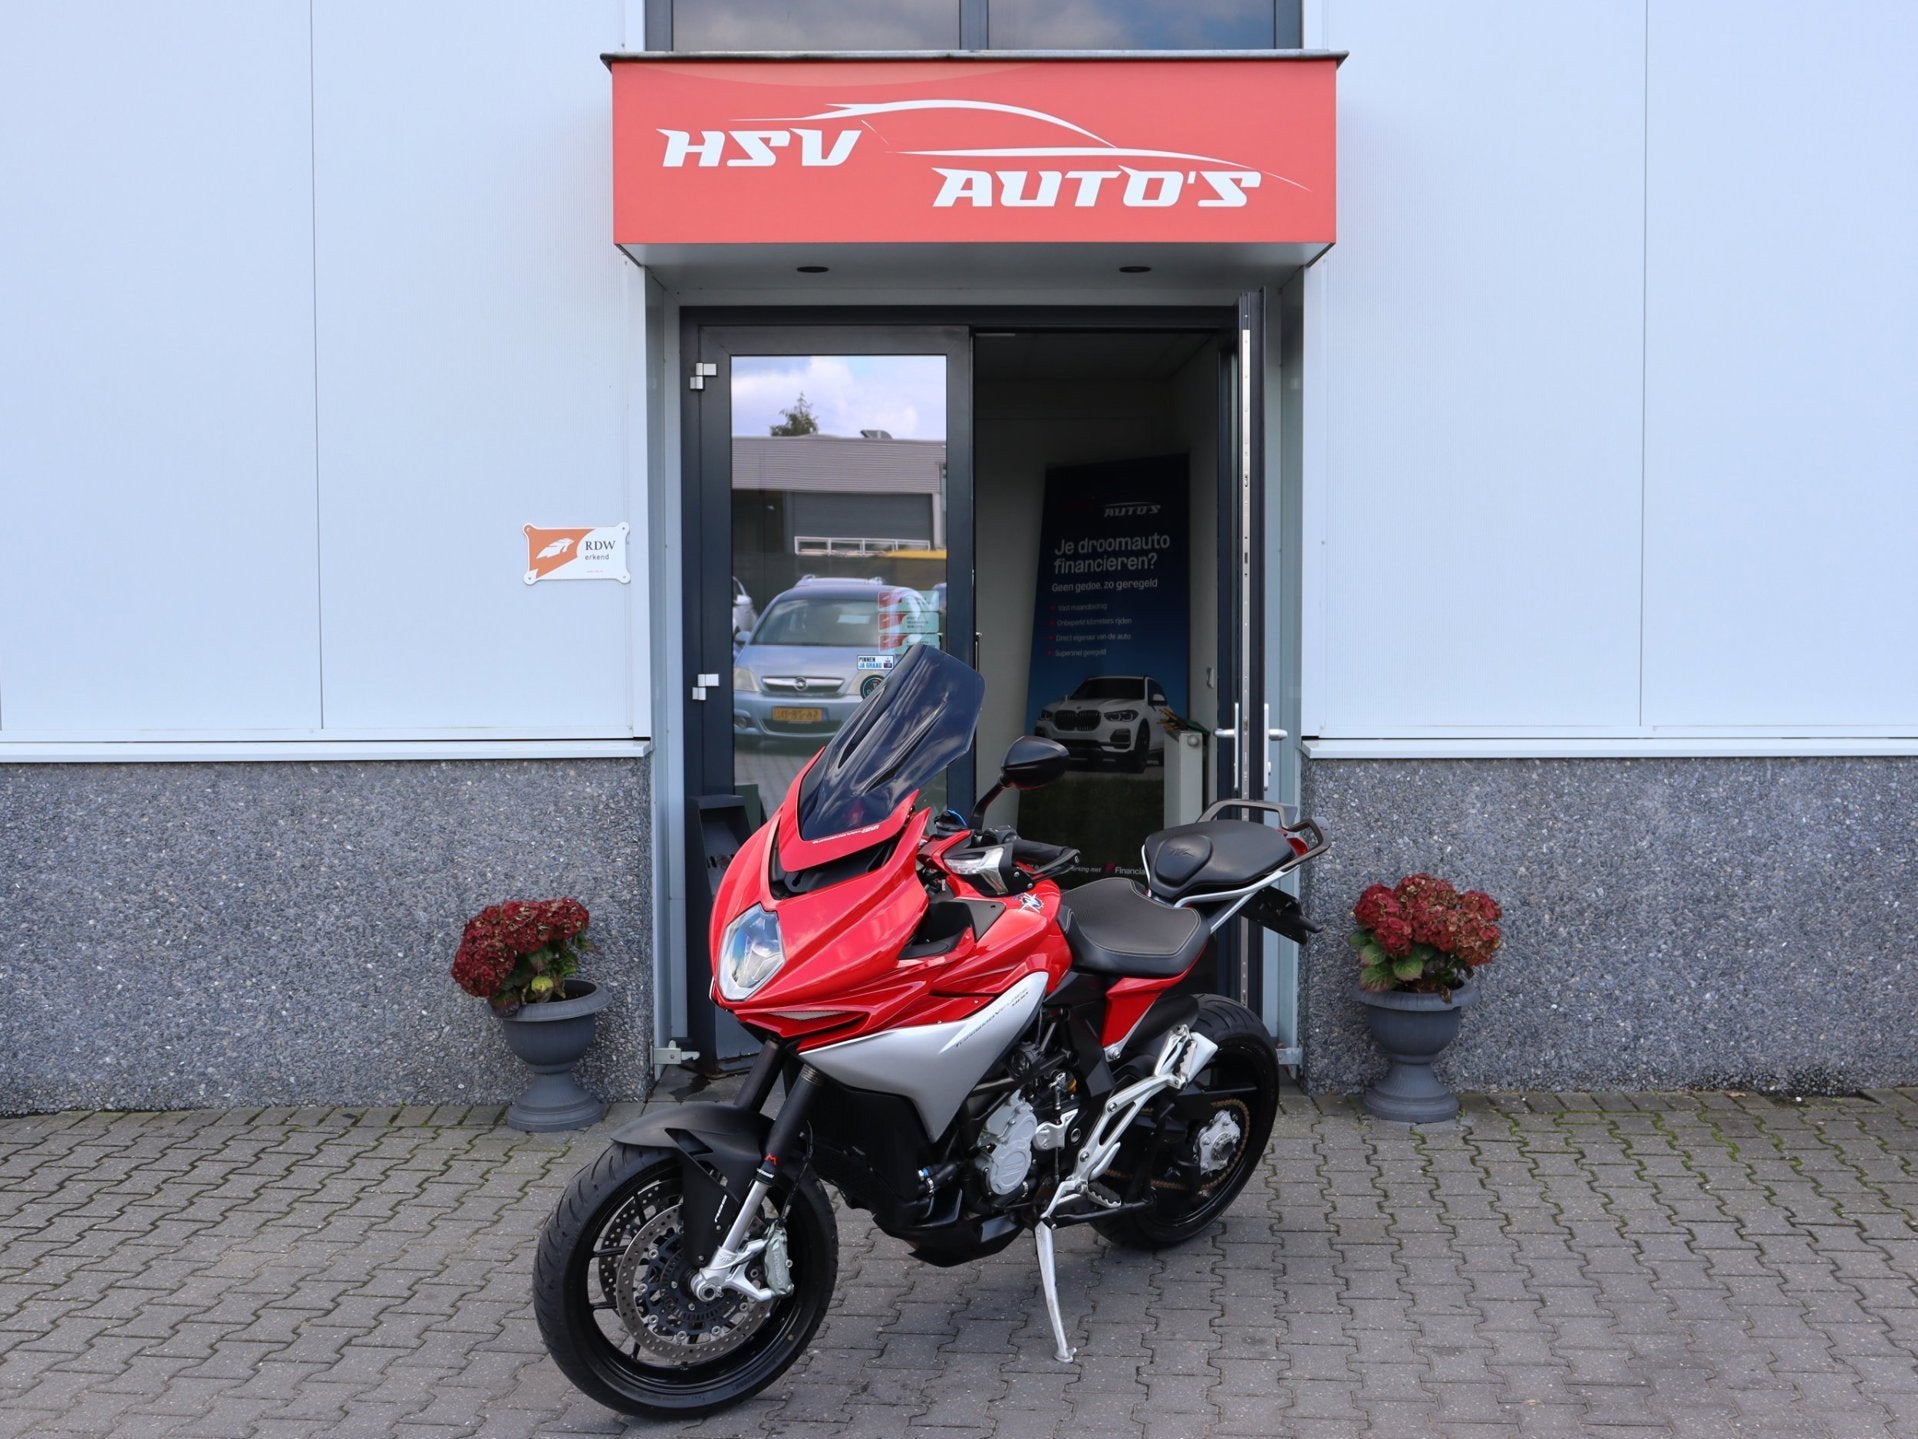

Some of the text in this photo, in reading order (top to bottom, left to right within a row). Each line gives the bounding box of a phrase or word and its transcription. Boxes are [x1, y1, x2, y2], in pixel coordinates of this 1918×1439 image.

[656, 128, 862, 167] HSV
[931, 164, 1261, 207] AUTO'S
[585, 540, 616, 551] RDW
[1054, 532, 1170, 556] Je droomauto
[585, 553, 610, 561] erkend
[1054, 553, 1158, 574] financieren?
[1052, 583, 1074, 593] Geen
[1104, 581, 1115, 590] zo
[1116, 578, 1158, 592] geregeld
